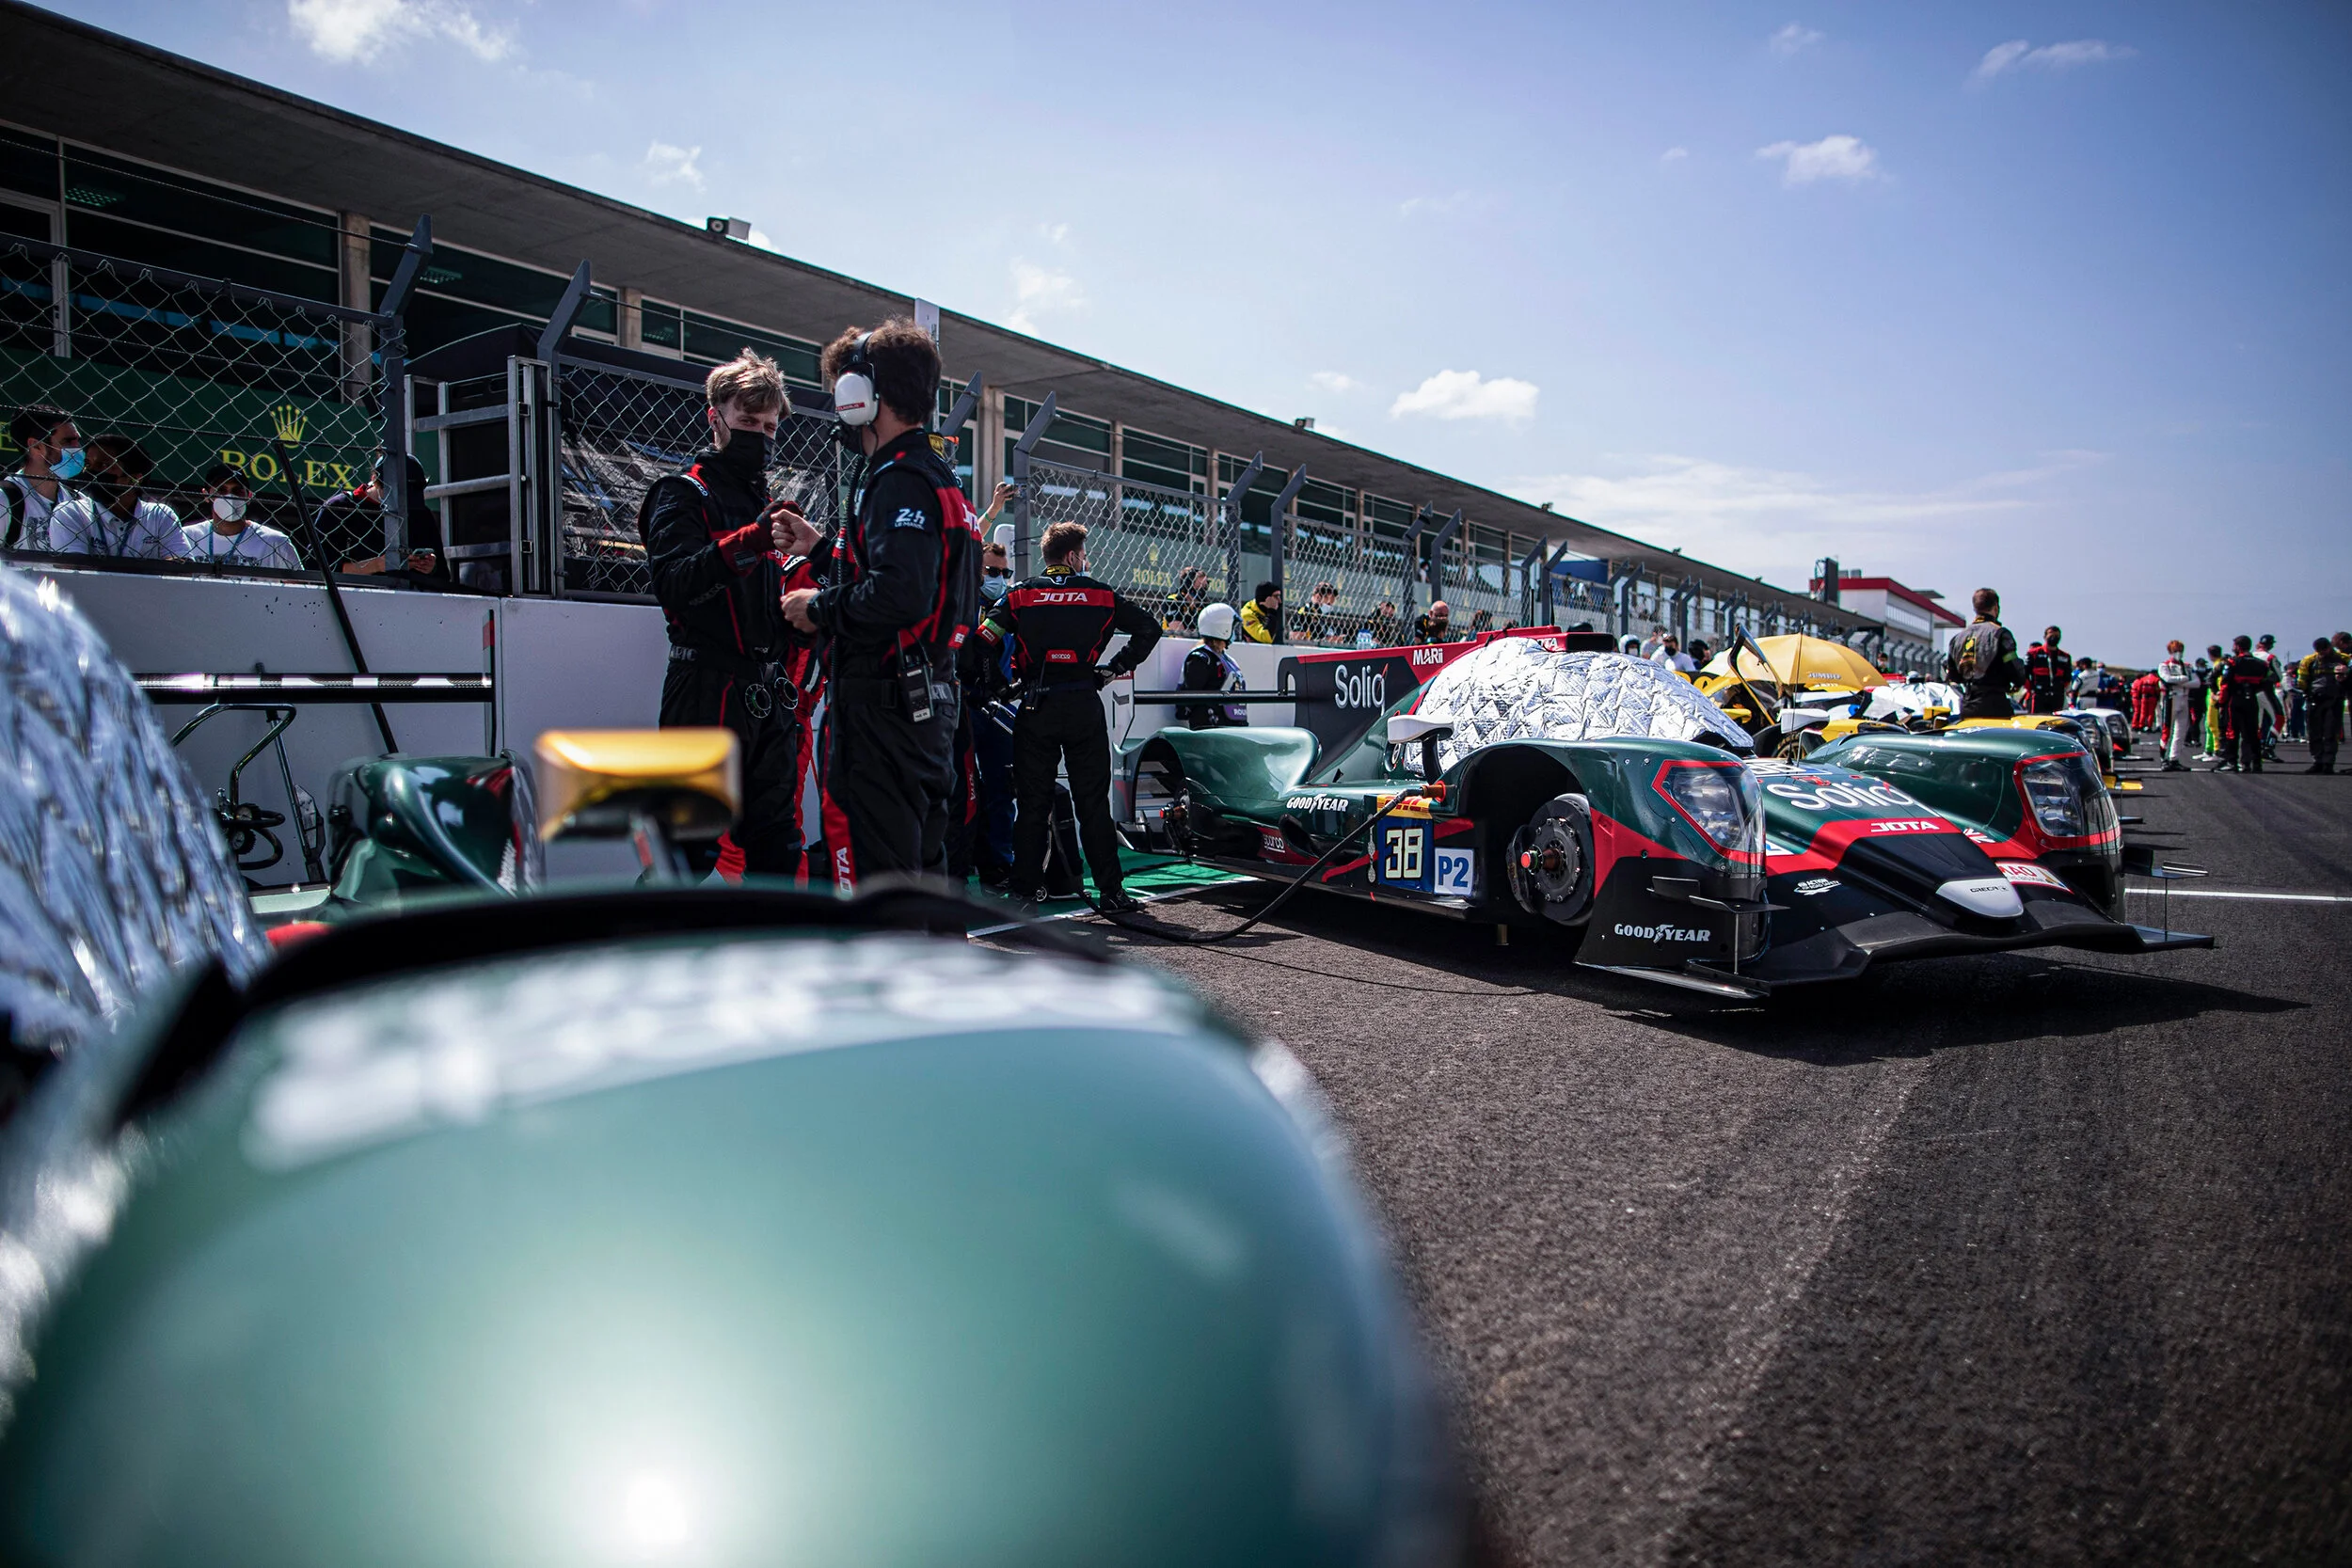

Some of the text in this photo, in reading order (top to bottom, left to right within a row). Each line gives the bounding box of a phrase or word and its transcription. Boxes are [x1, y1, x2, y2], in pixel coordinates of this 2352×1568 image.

[1033, 592, 1088, 602] JOTA
[1286, 794, 1349, 814] GOODYEAR
[1870, 821, 1940, 833] JOTA
[1385, 828, 1424, 879] 38
[1438, 855, 1470, 888] P2
[1613, 923, 1711, 943] GOODYEAR
